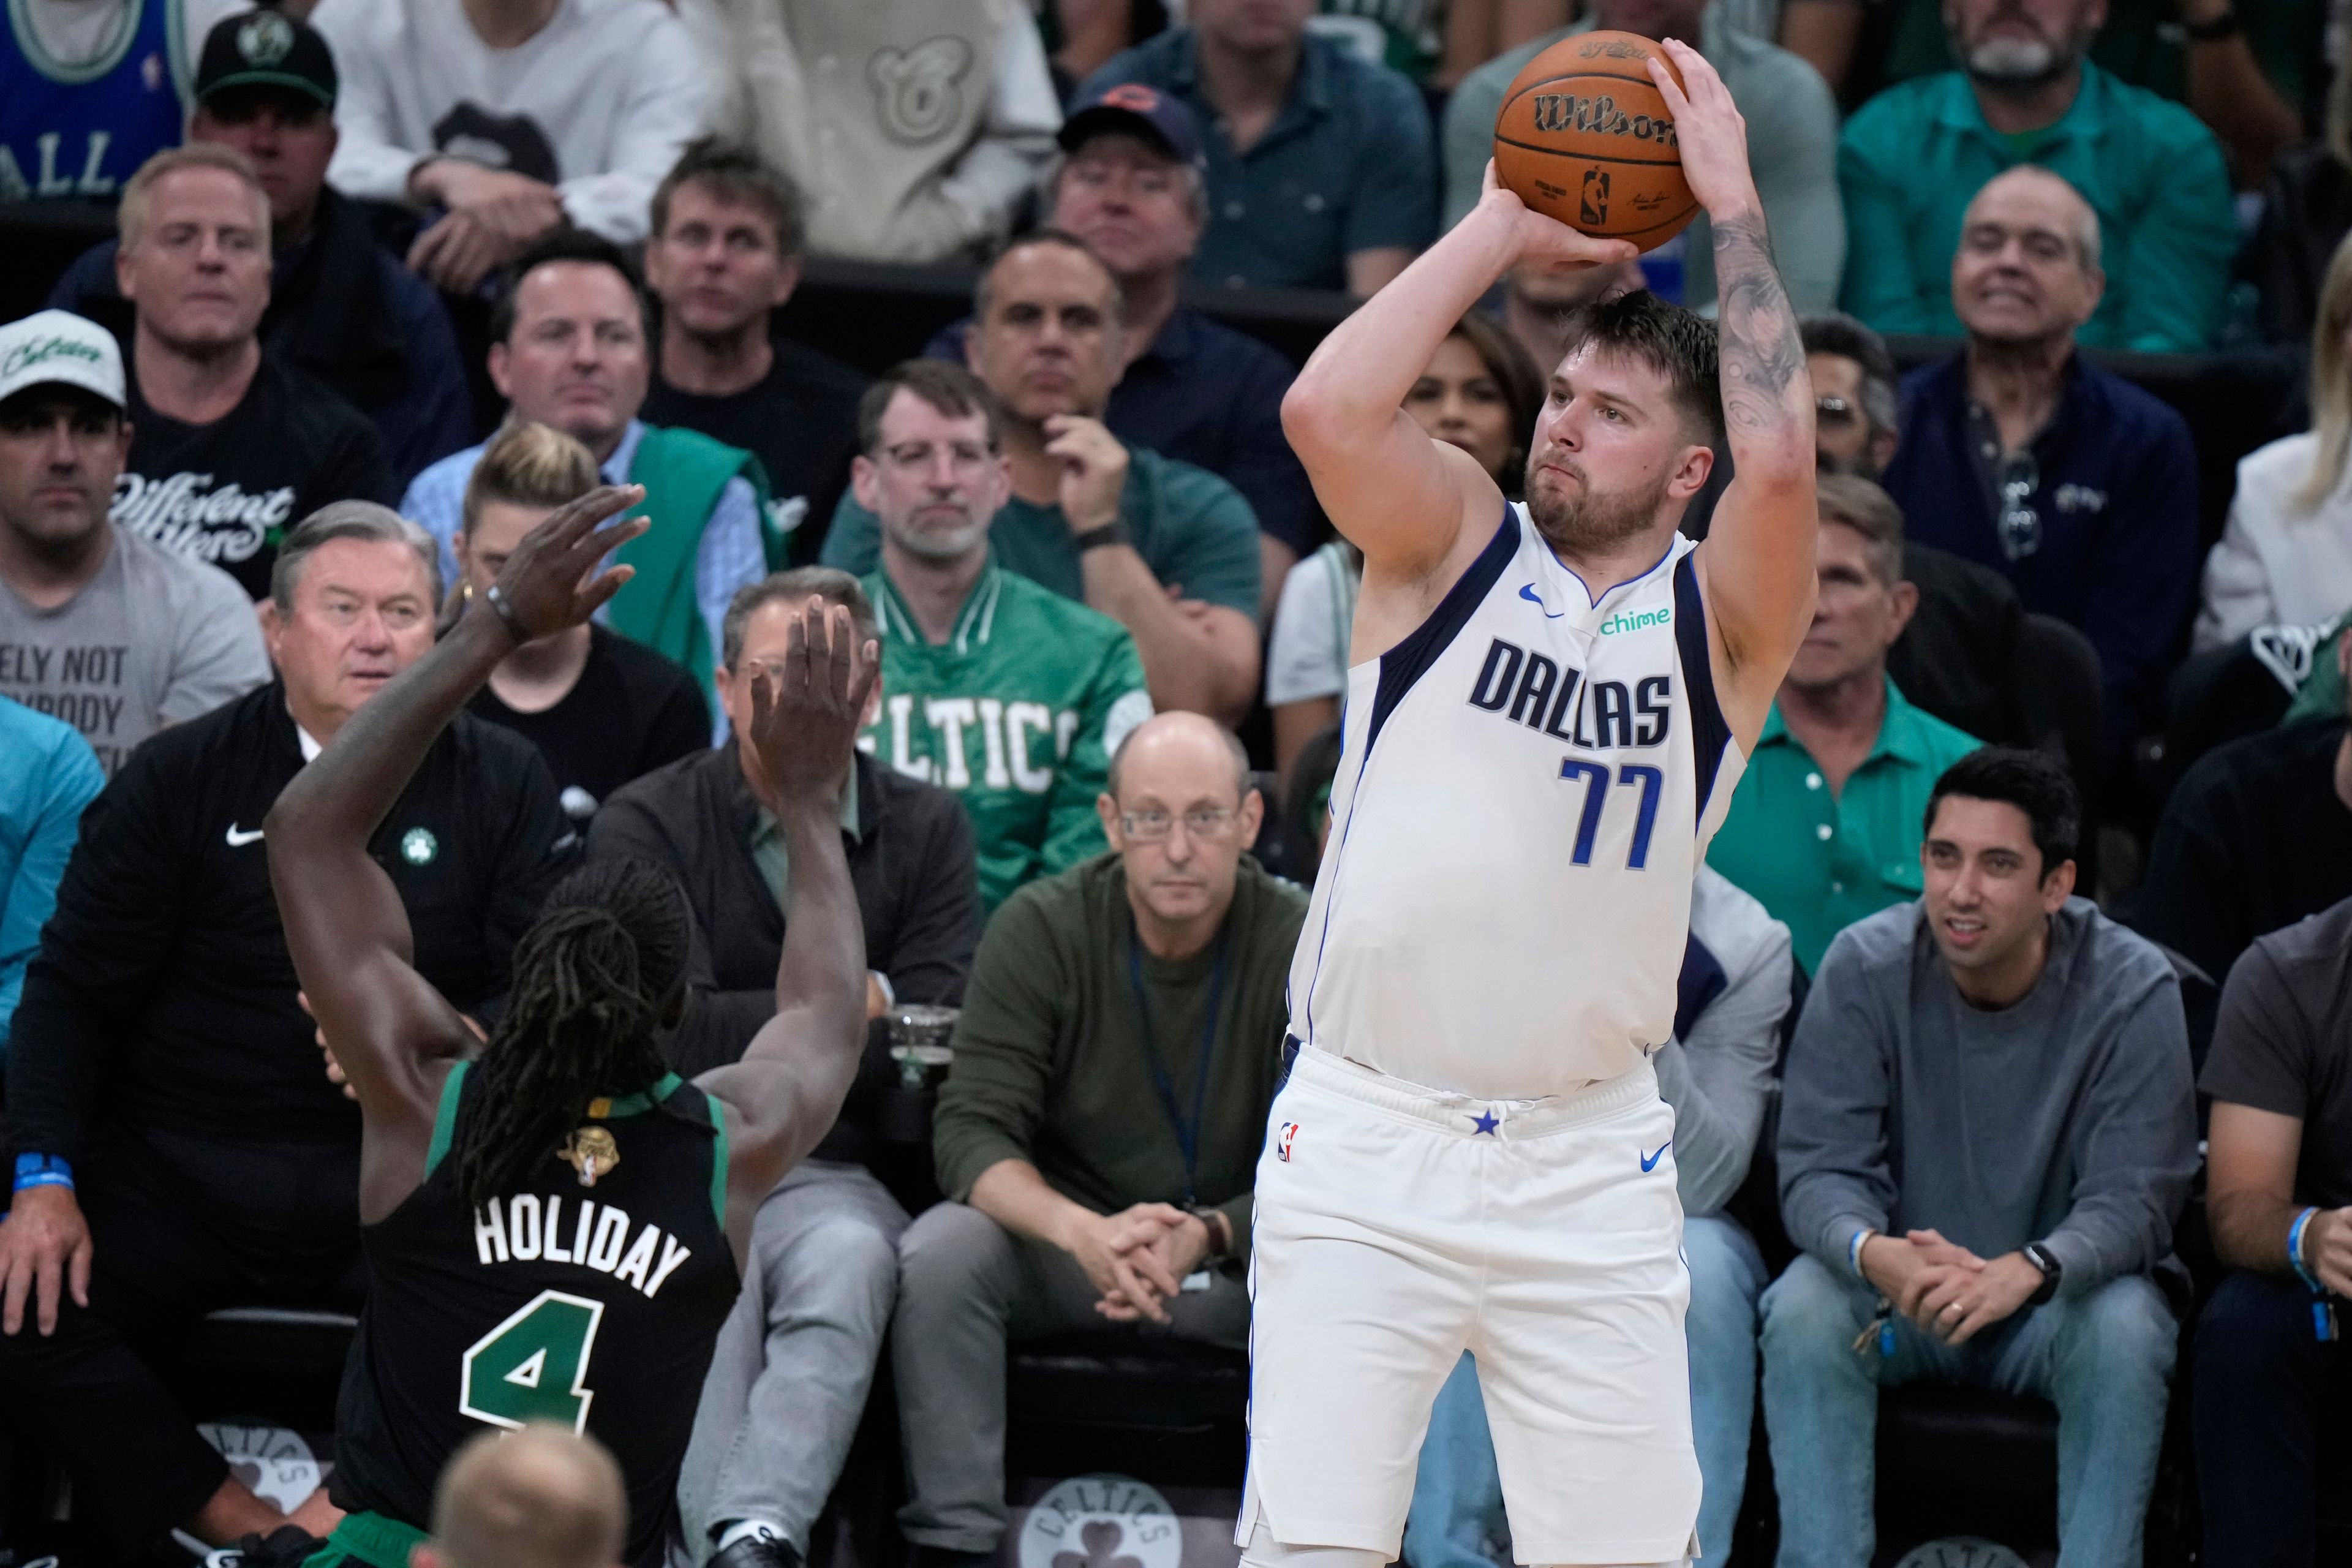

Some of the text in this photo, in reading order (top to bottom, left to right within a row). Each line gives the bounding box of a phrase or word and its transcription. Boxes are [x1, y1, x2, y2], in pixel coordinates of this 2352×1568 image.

[1534, 94, 1679, 148] Wilson
[62, 646, 128, 687] NOT
[1600, 608, 1671, 636] chime
[856, 693, 1079, 794] LTIC
[1466, 635, 1672, 751] DALLAS
[1558, 756, 1665, 872] 77
[475, 1193, 692, 1298] HOLIDAY
[459, 1289, 605, 1439] 4
[1035, 1479, 1170, 1543] CELTICS
